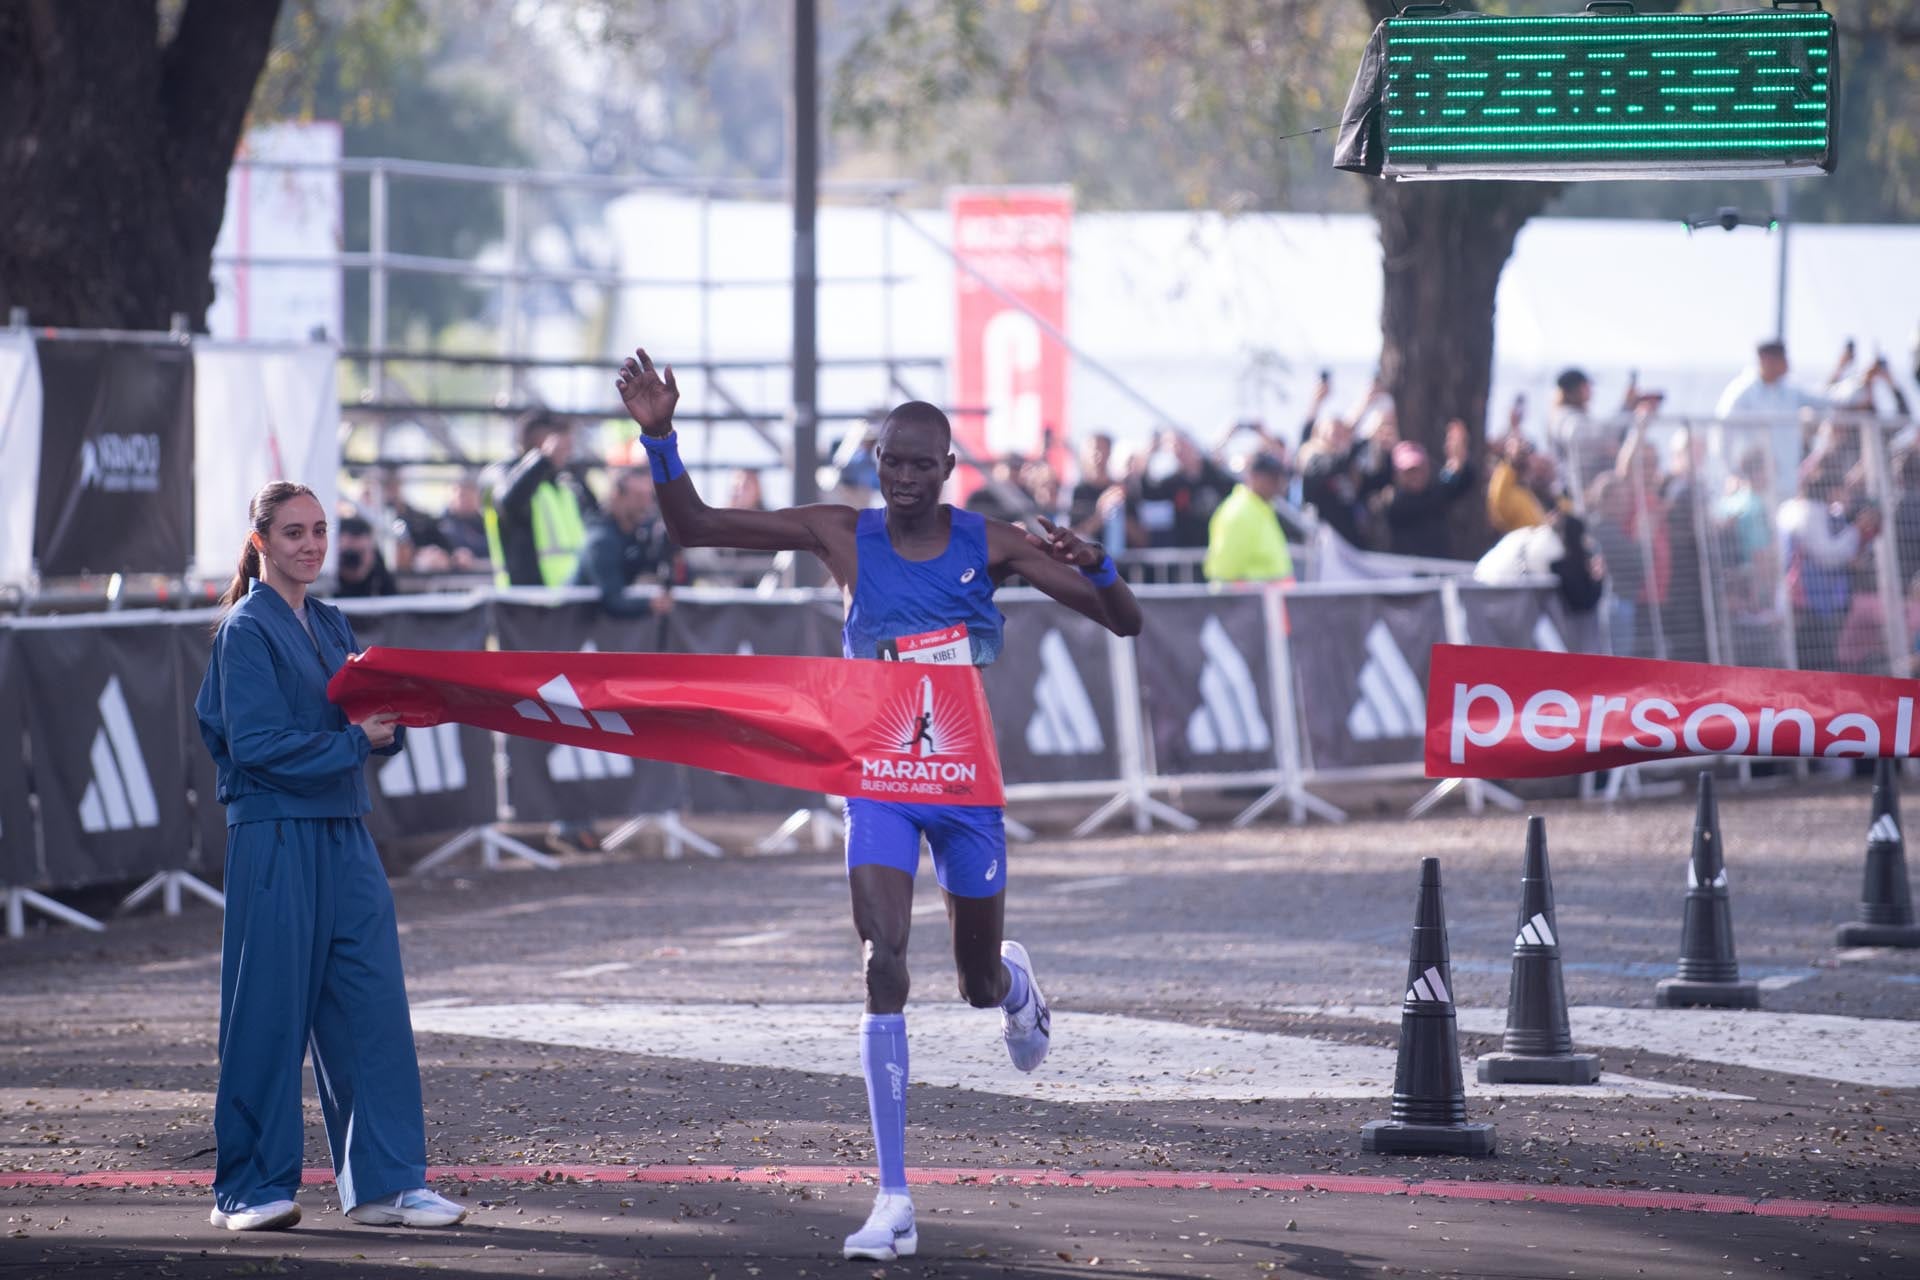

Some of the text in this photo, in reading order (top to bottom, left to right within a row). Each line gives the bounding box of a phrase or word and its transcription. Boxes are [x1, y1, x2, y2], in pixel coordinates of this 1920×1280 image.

[932, 648, 957, 662] KIBET
[1450, 683, 1914, 765] personal
[862, 759, 976, 782] MARATON
[861, 780, 909, 793] BUENOS
[910, 782, 943, 795] AIRES
